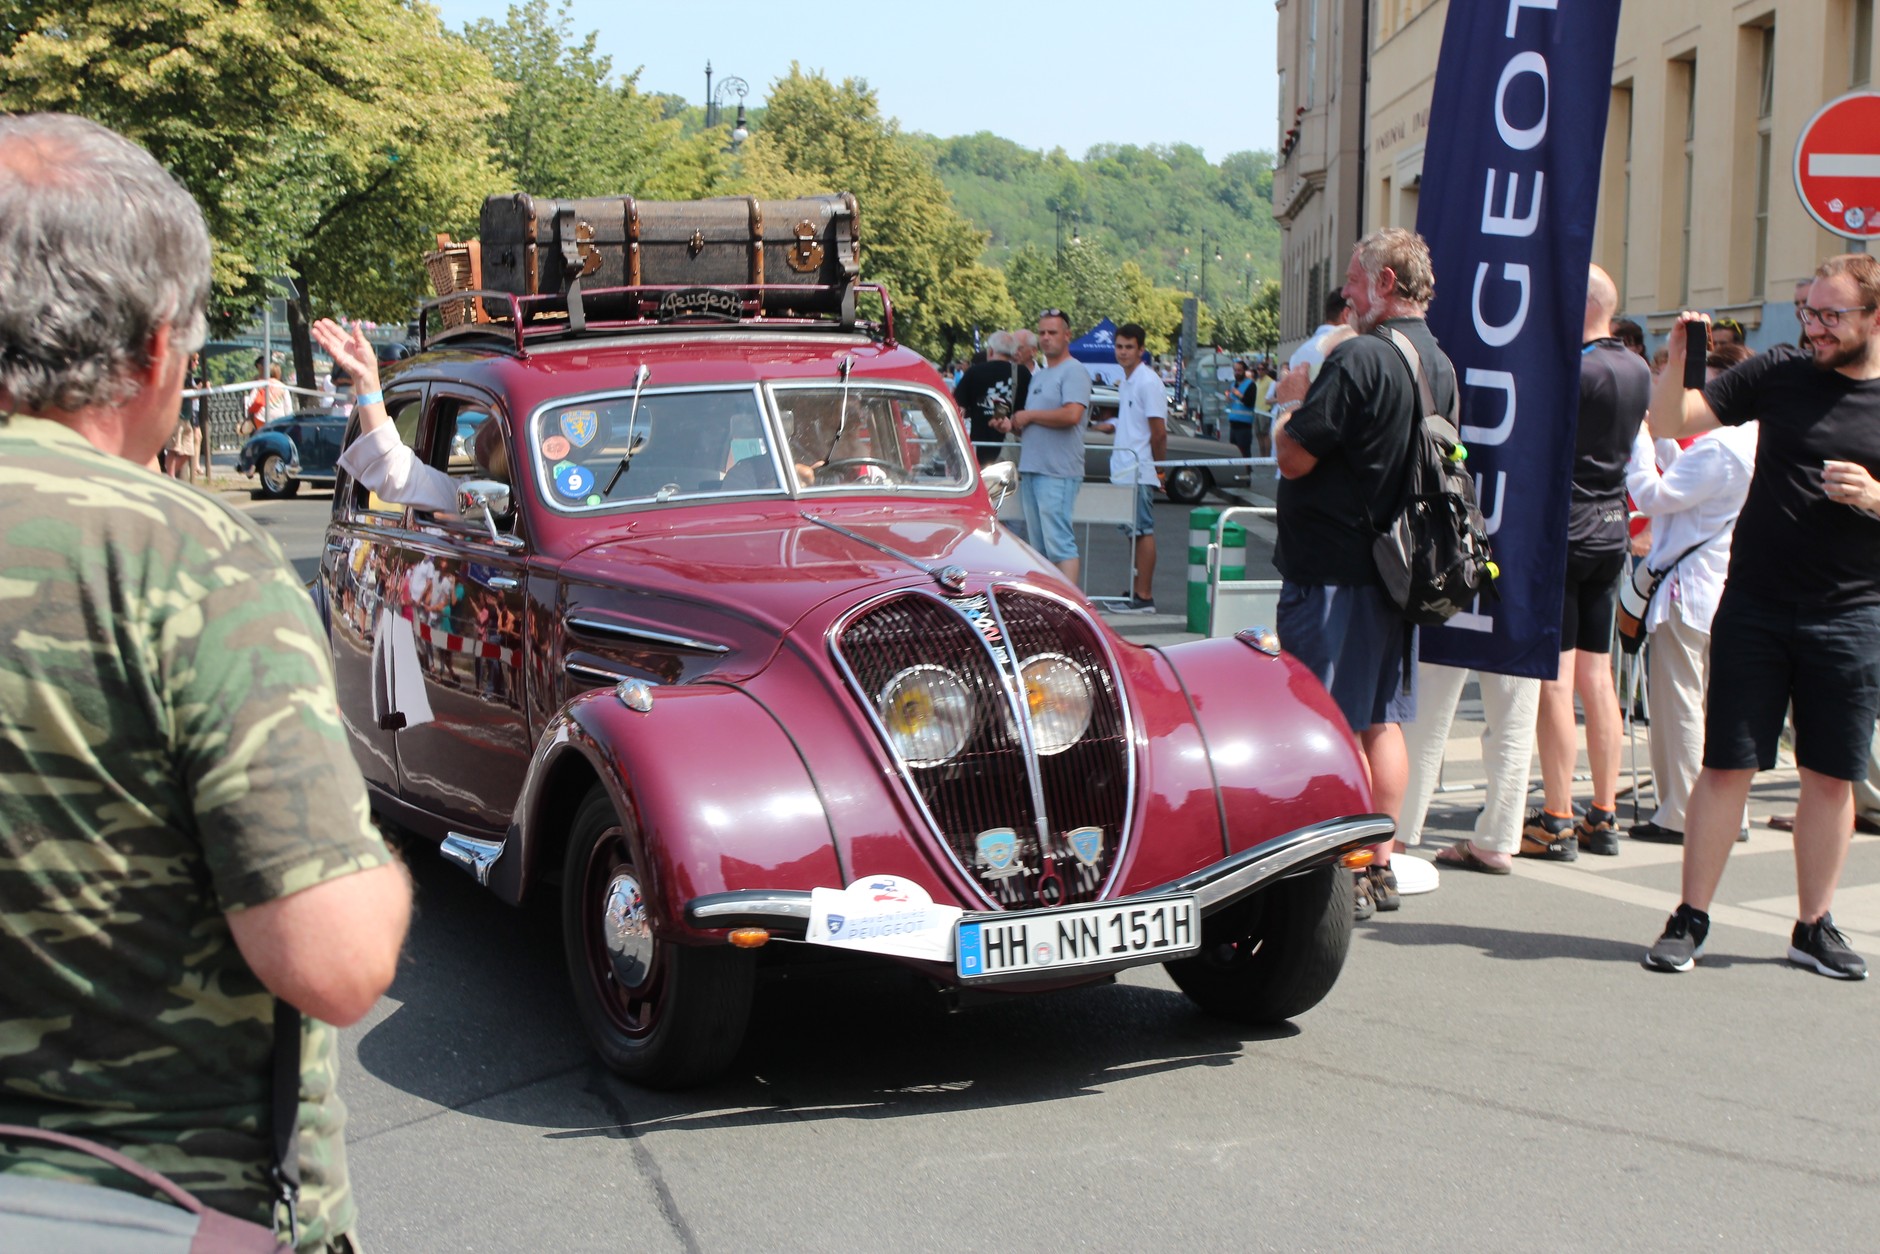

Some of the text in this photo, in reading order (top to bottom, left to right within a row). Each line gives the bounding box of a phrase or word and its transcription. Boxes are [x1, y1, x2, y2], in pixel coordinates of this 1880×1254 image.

[568, 474, 583, 491] 9
[847, 919, 926, 940] PEUGEOT
[965, 904, 1191, 969] D HH NN 151H
